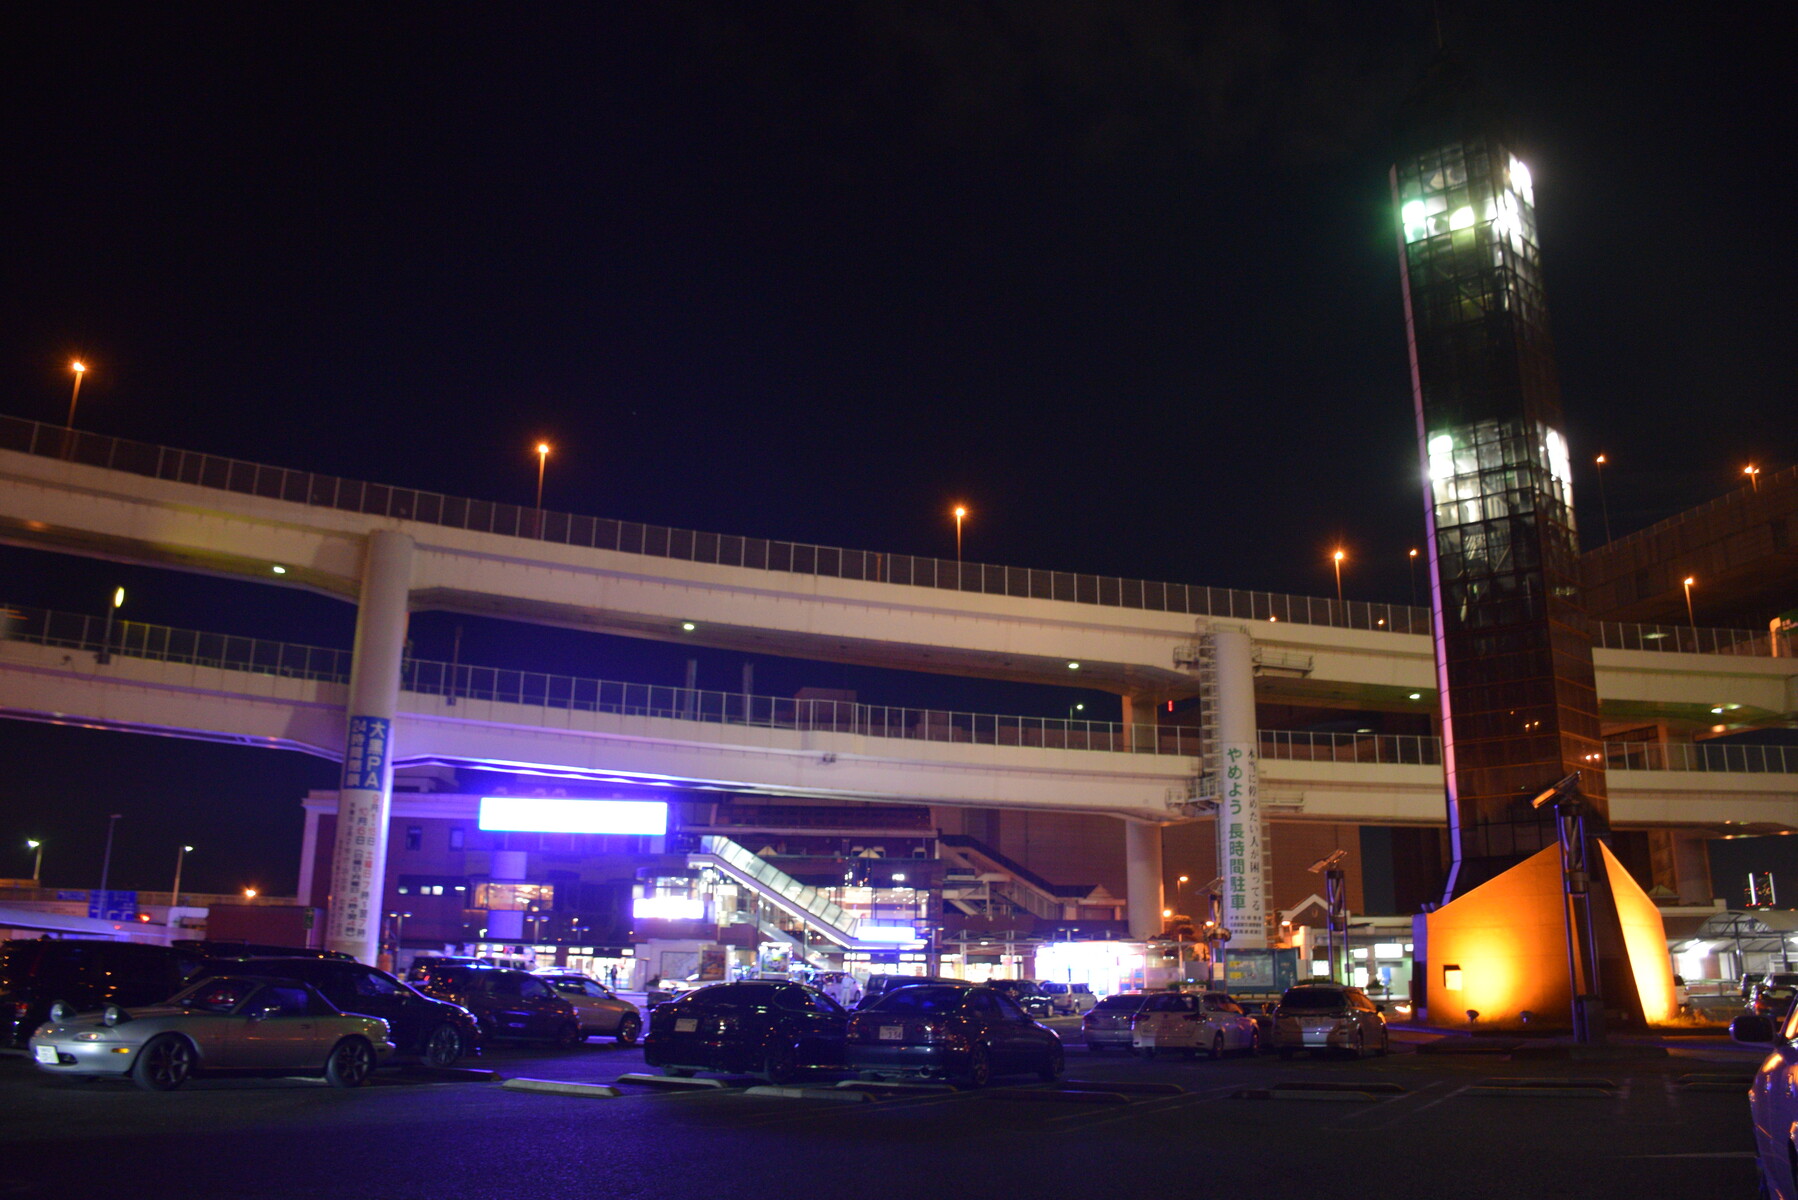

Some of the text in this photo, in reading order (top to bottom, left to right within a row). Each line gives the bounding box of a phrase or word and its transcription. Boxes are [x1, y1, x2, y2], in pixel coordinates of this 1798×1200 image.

[363, 721, 386, 788] 大黒PA
[1227, 747, 1243, 815] やめよう
[1228, 823, 1246, 910] 長時間駐車
